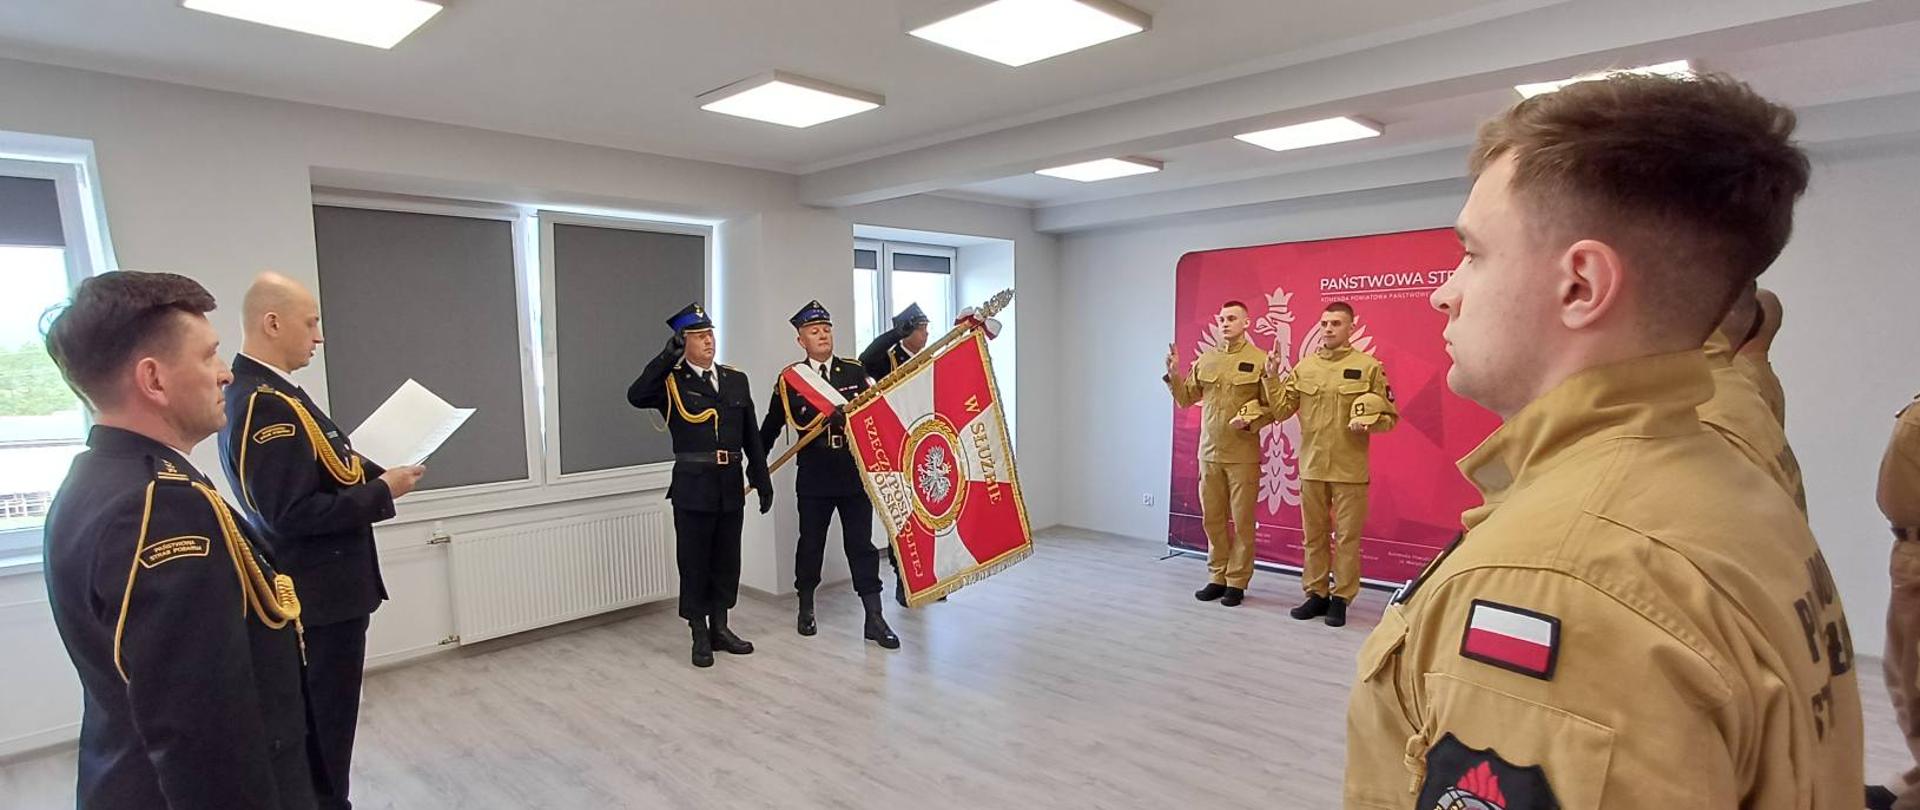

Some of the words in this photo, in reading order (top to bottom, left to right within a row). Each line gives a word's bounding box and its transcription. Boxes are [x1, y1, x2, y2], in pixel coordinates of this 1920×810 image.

[1320, 271, 1424, 291] PAŃSTWOWA
[964, 394, 981, 412] W
[863, 415, 924, 578] RZECZYPOSPOLITEJ
[868, 462, 906, 538] POLSKIEJ
[969, 421, 1002, 505] SŁUŻBIE
